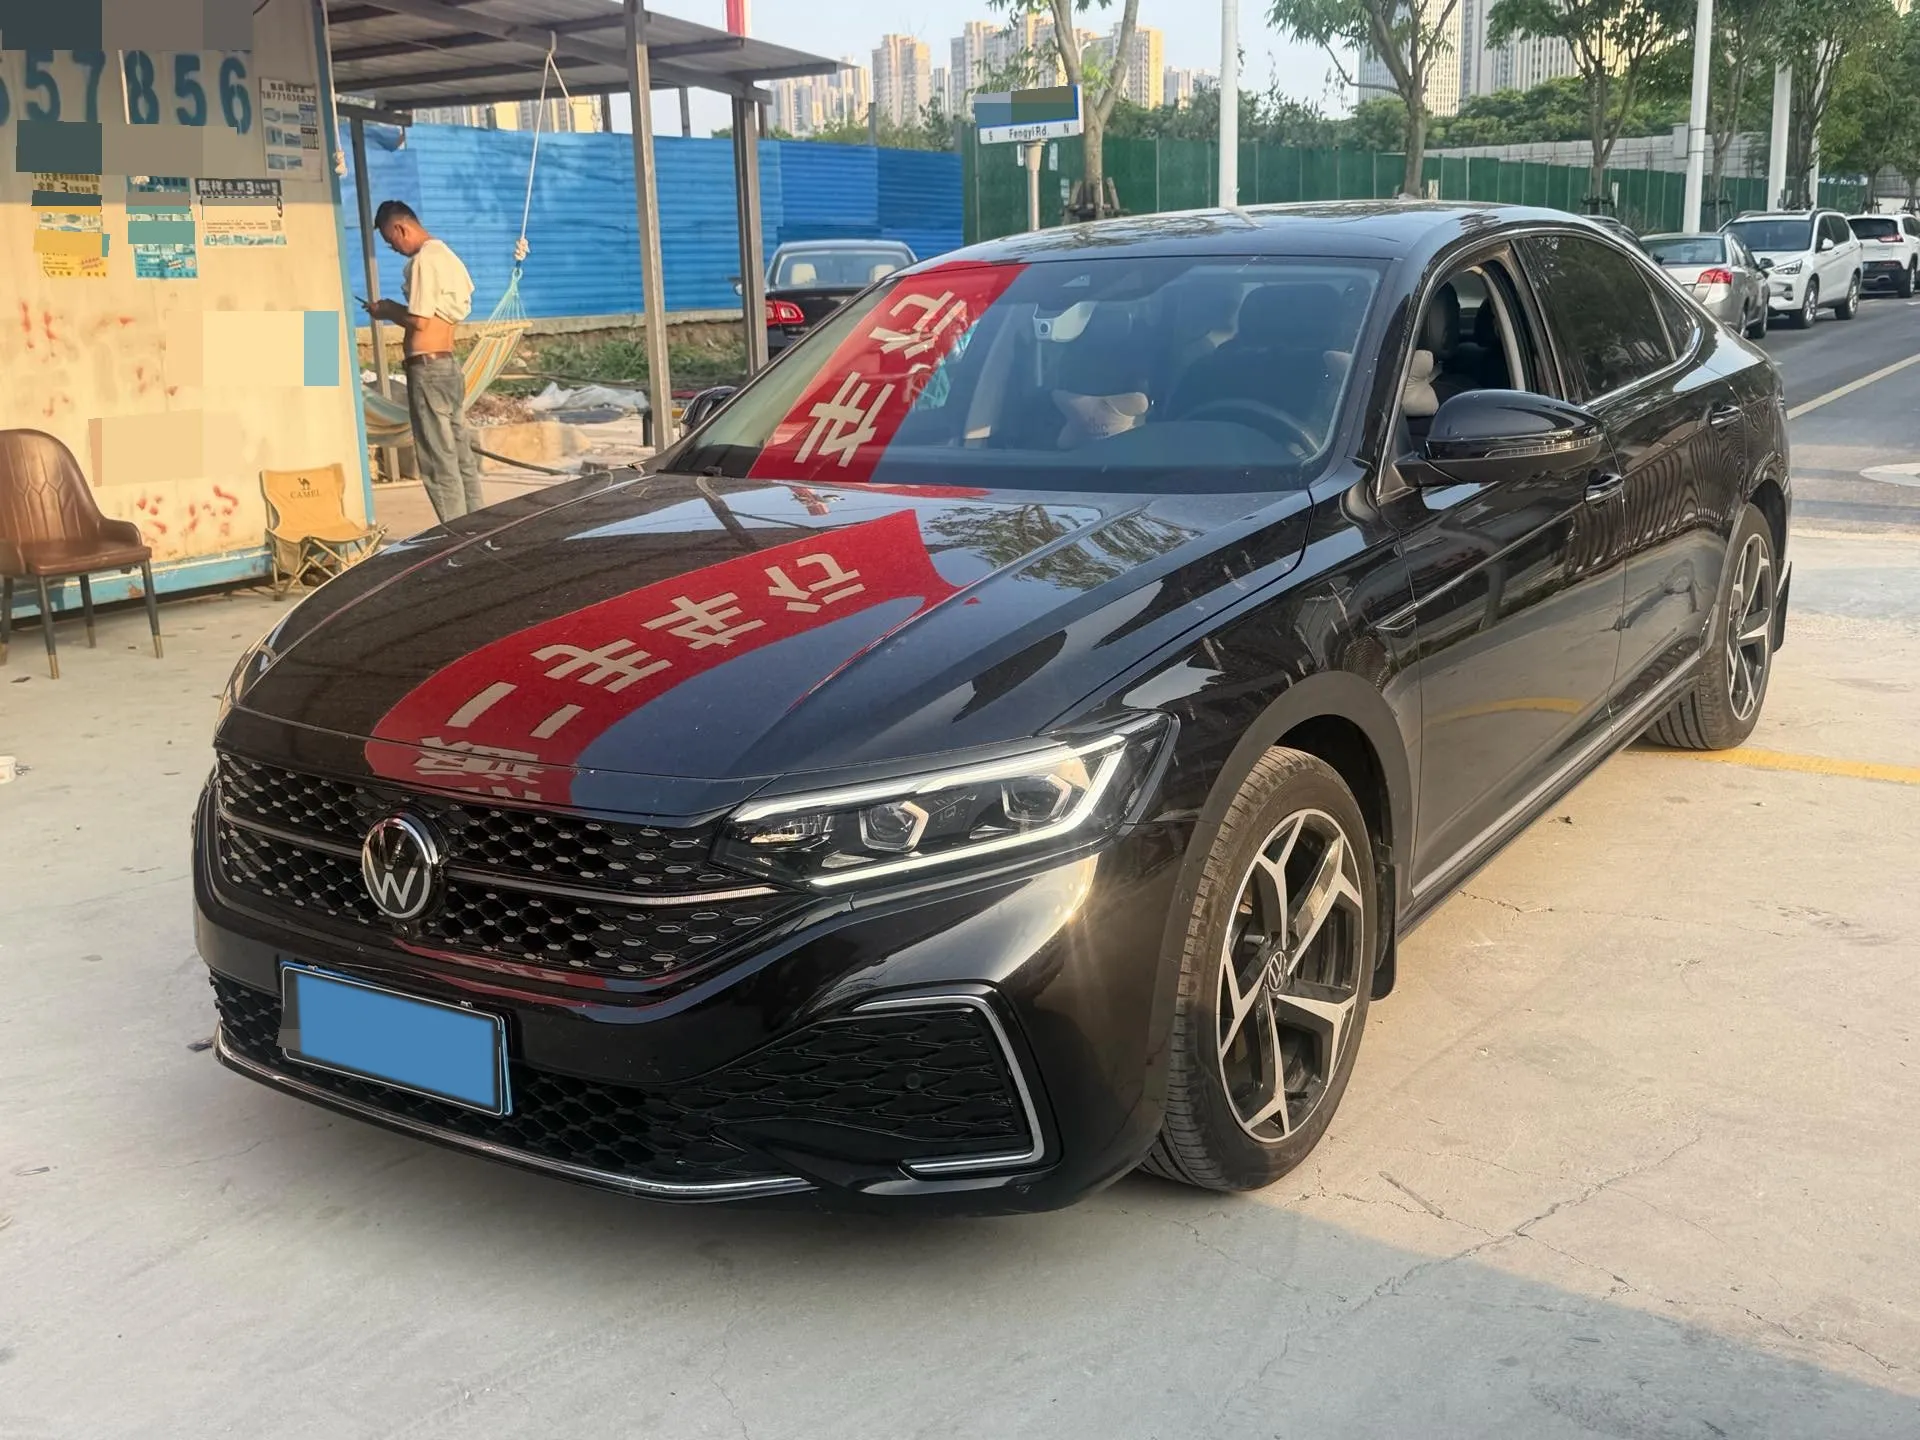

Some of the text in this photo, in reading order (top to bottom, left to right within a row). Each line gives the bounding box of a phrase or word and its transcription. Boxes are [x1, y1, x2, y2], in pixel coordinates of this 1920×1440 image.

[0, 49, 252, 135] 57856
[1009, 126, 1035, 140] Fengyi
[1064, 123, 1070, 134] N
[290, 489, 320, 499] CAMEL
[362, 818, 431, 918] VW
